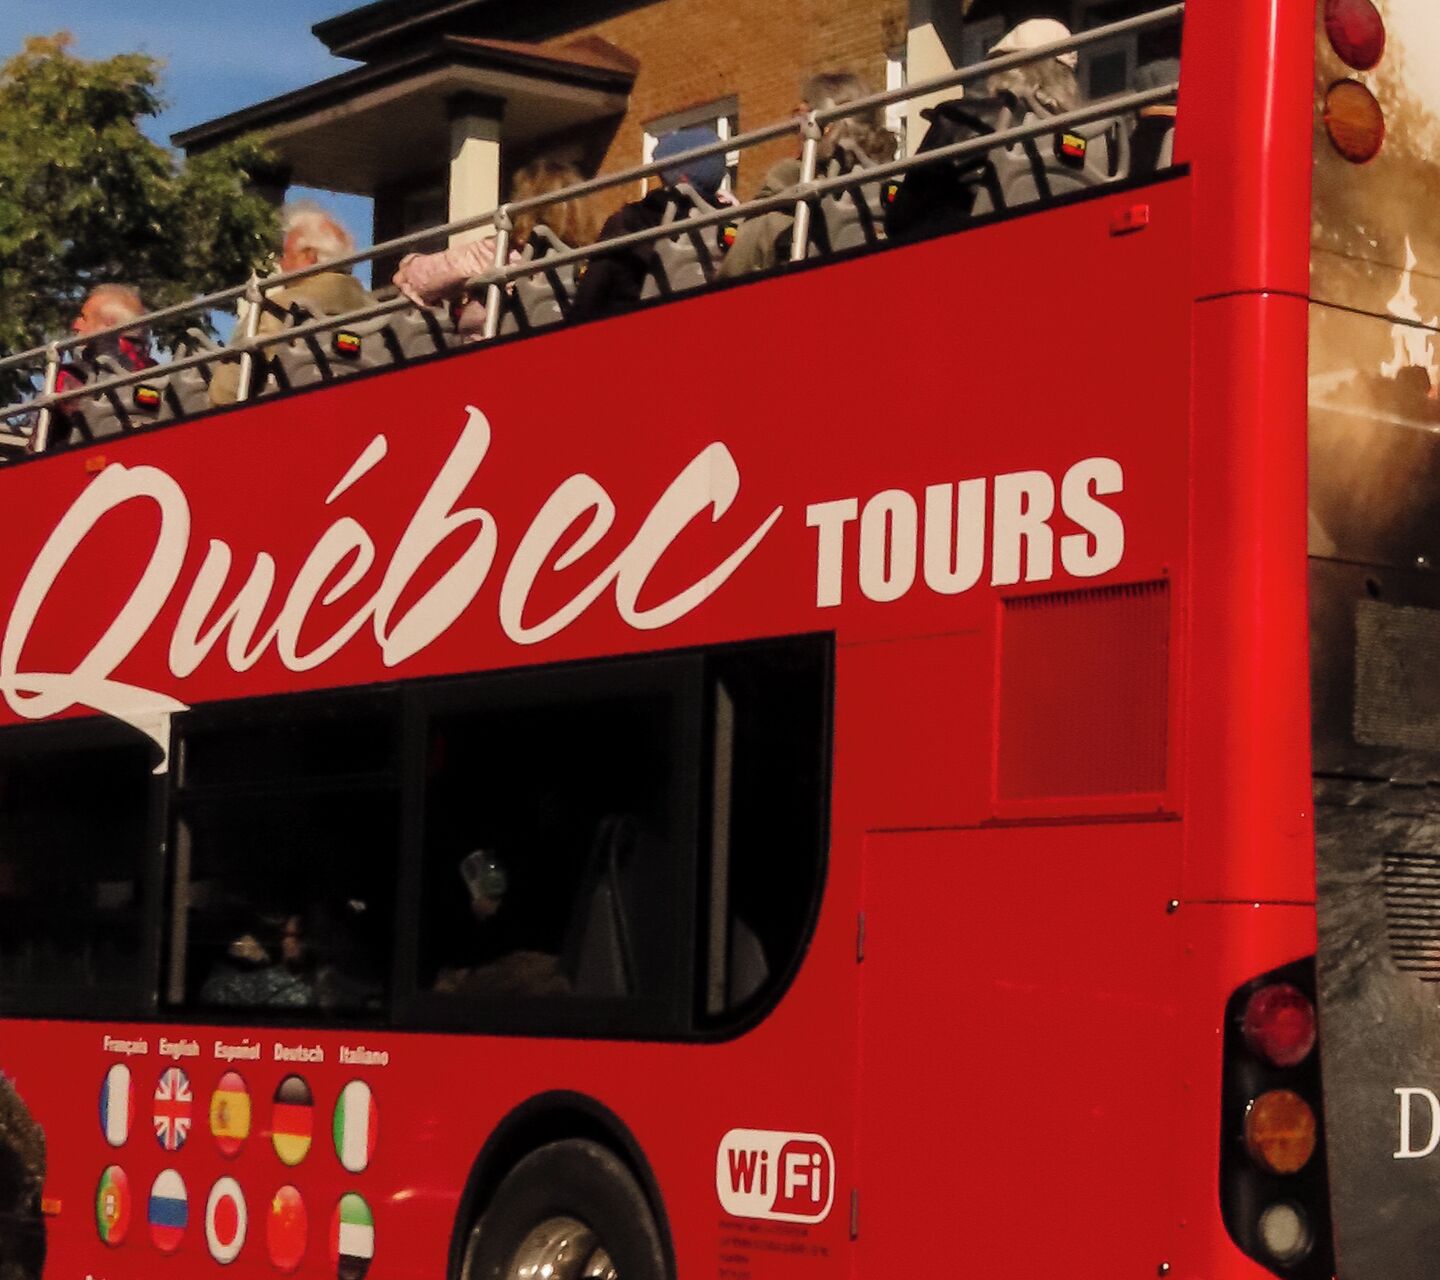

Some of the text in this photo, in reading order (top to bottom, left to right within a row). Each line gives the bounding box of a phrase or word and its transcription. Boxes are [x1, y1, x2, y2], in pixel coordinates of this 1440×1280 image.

[0, 404, 1124, 775] Québec TOURS
[274, 1042, 324, 1062] Deutsch
[339, 1045, 389, 1066] Italiano
